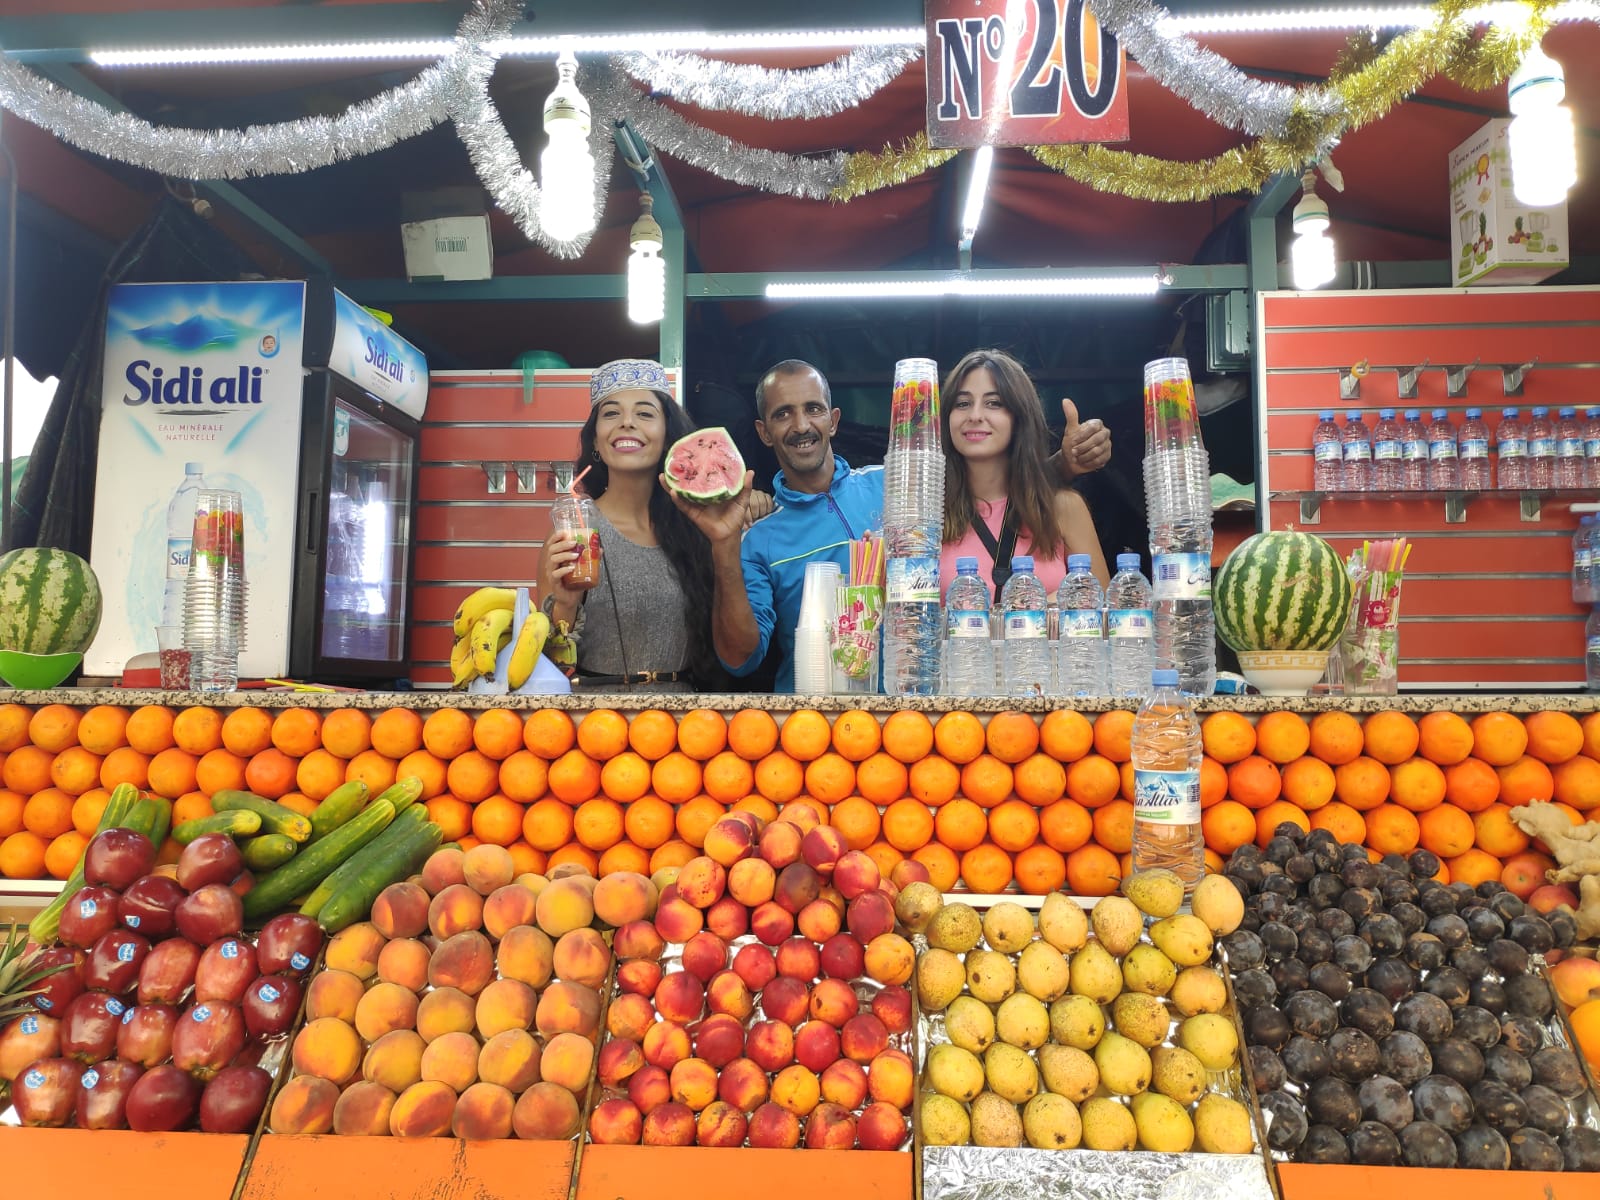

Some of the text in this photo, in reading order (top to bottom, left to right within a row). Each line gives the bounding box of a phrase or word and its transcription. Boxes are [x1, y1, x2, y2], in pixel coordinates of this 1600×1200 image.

[1007, 0, 1121, 118] 20
[364, 335, 389, 373] Sidi
[389, 359, 404, 383] ali
[123, 360, 263, 406] Sidi ali
[158, 424, 175, 432] EAU
[165, 433, 216, 441] NATURELLE
[171, 551, 189, 566] Sid
[1144, 791, 1180, 807] Atlas
